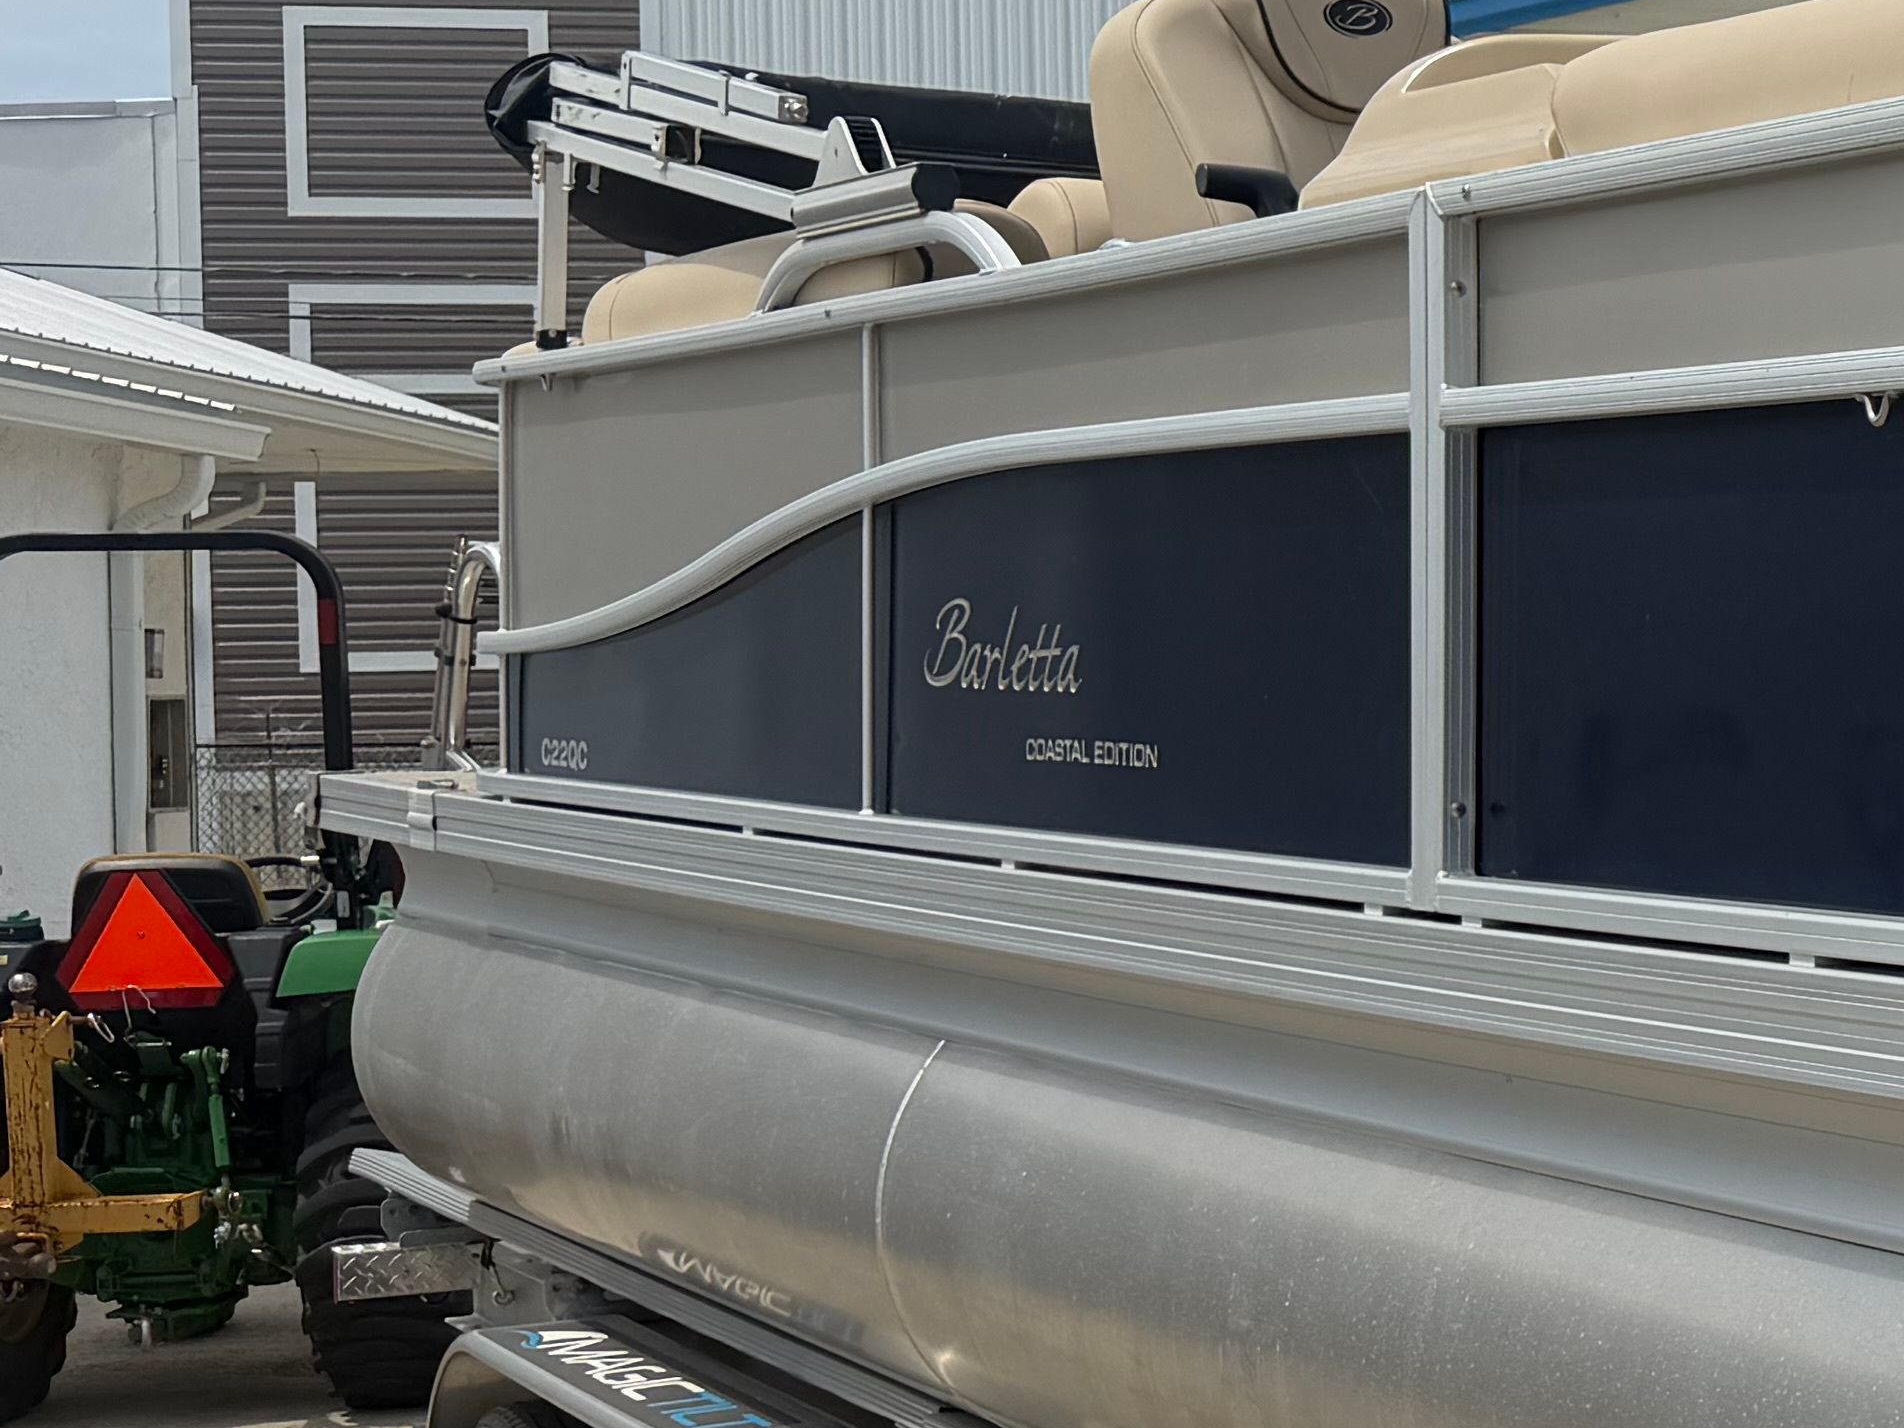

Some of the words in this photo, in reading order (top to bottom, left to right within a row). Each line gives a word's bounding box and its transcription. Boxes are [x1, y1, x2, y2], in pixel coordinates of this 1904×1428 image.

[924, 598, 1082, 693] Barletta
[541, 738, 588, 771] C22QC
[1025, 738, 1091, 764] COASTAL
[1094, 741, 1159, 768] EDITION
